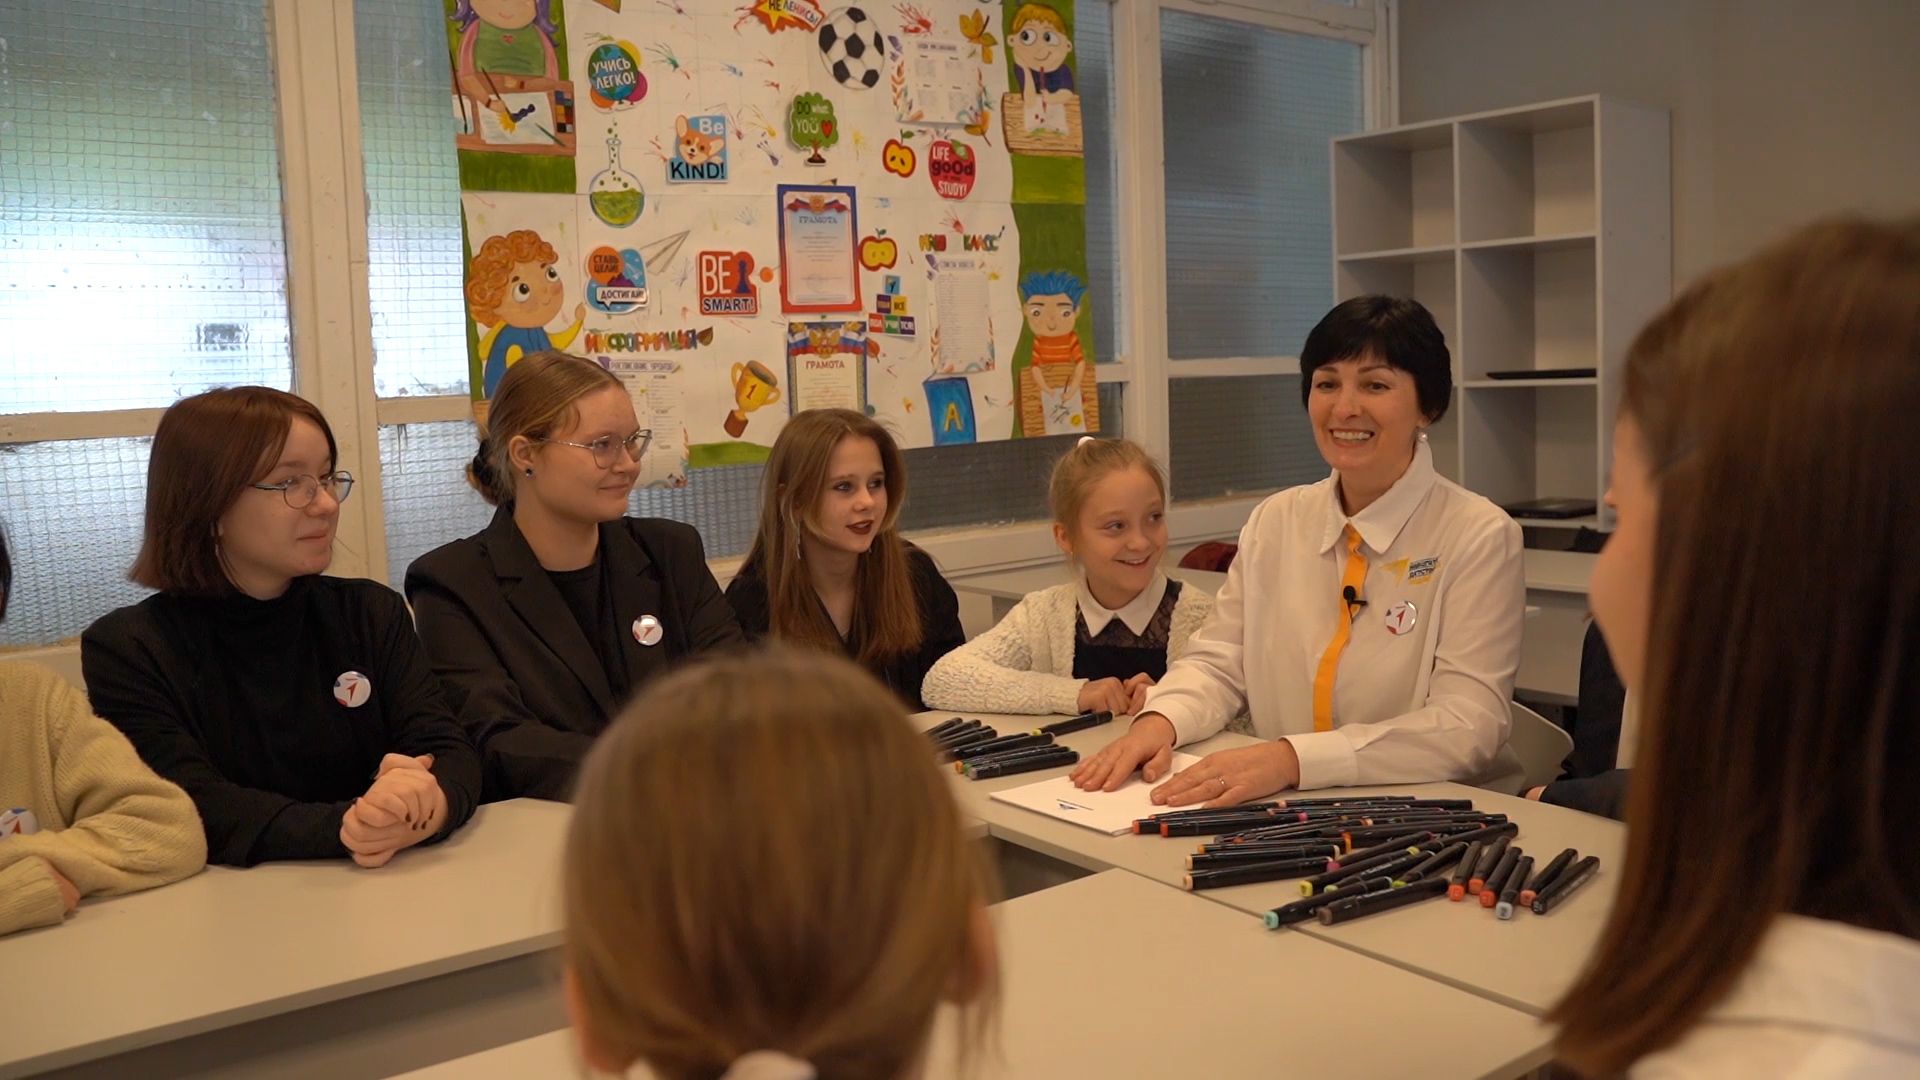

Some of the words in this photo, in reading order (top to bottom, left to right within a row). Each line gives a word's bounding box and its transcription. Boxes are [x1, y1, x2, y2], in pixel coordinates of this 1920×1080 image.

[768, 0, 781, 11] НЕ
[592, 58, 631, 73] УЧИСЬ
[596, 71, 636, 89] ЛЕГКО!
[796, 101, 811, 115] DO
[700, 118, 724, 134] Be
[796, 119, 819, 134] YOU
[932, 146, 950, 160] LIFE
[671, 162, 725, 179] KIND!
[938, 180, 968, 197] STUDY!
[798, 216, 838, 224] ГРАМОТА
[963, 234, 999, 252] КЛАСС
[702, 255, 732, 295] BE
[703, 298, 754, 312] SMART!
[585, 329, 698, 353] ИНФОРМАЦИЯ
[805, 360, 845, 369] ГРАМОТА
[746, 383, 757, 401] 1
